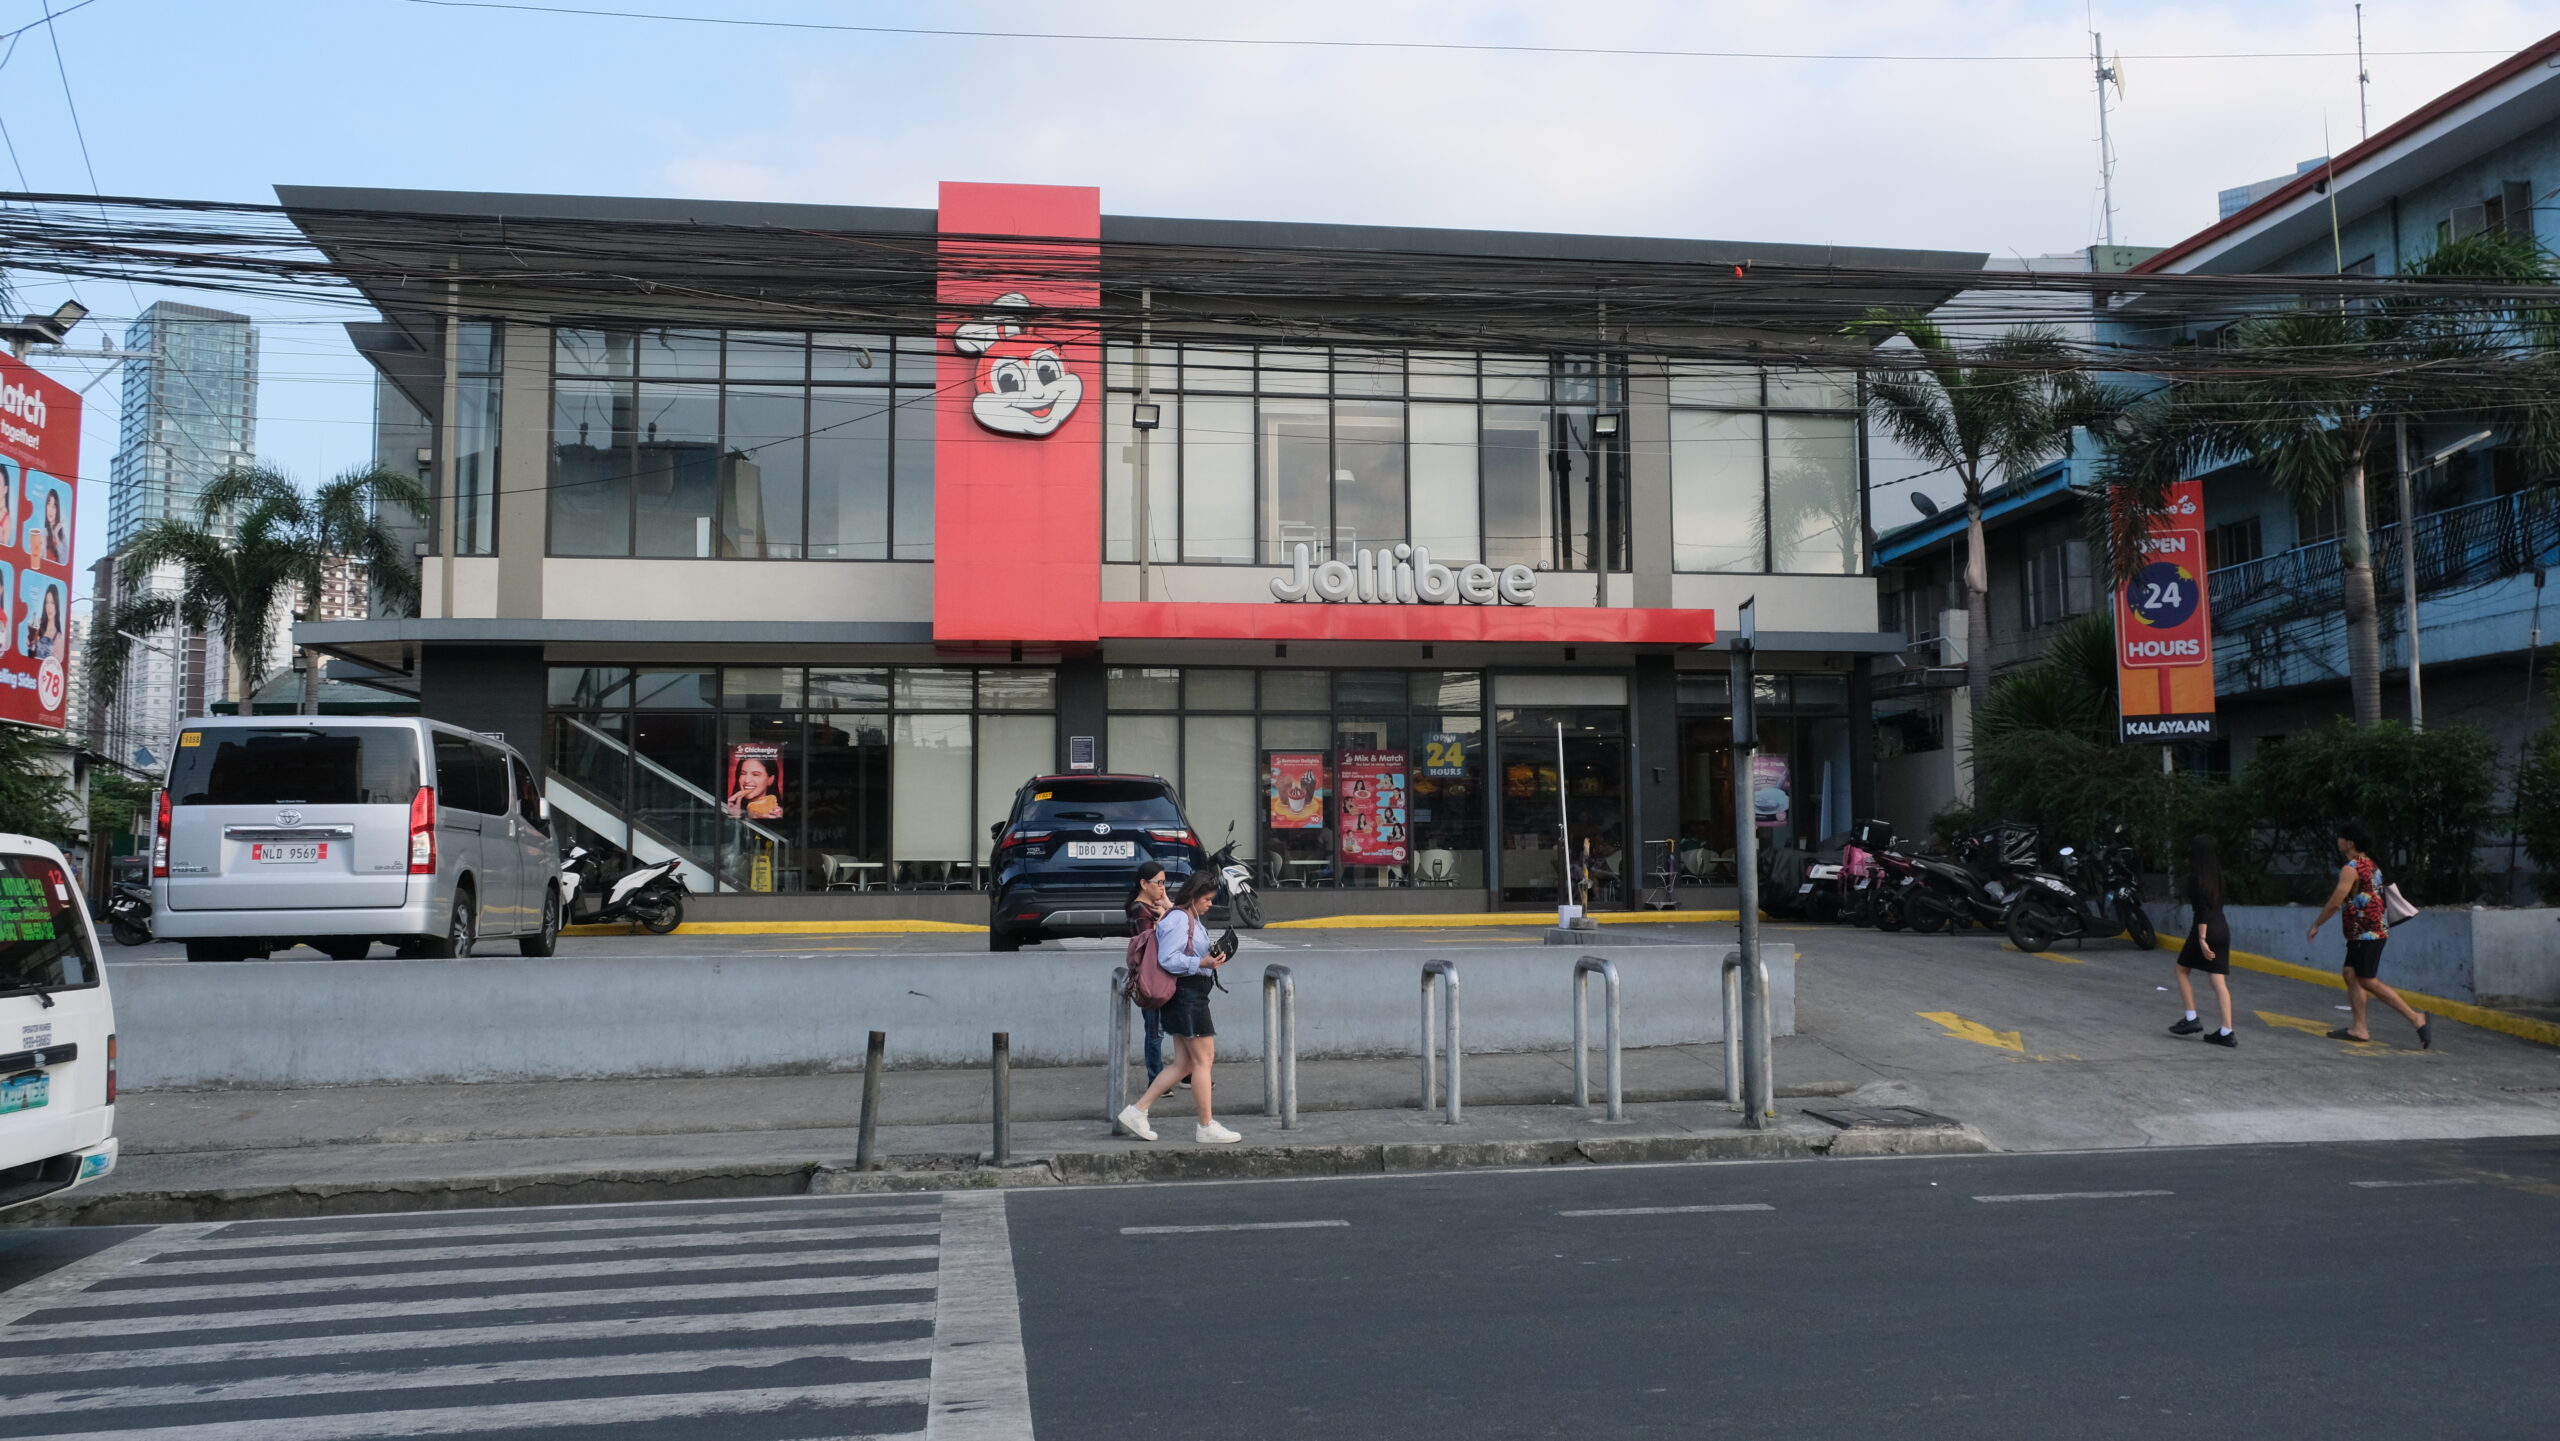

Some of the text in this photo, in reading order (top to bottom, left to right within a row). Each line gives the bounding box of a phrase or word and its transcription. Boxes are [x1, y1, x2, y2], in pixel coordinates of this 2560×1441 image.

[1, 418, 40, 450] together!
[1269, 542, 1538, 605] Jollibee
[2143, 581, 2183, 609] 24
[2128, 639, 2200, 658] HOURS
[2126, 719, 2210, 735] KALAYAAN
[744, 746, 778, 754] Chickenjoy
[1426, 742, 1465, 767] 24
[1354, 754, 1404, 762] Mix & Match
[1430, 768, 1462, 776] HOURS
[262, 847, 317, 859] NLD 9569
[1102, 844, 1126, 855] 2745
[48, 870, 65, 884] 12
